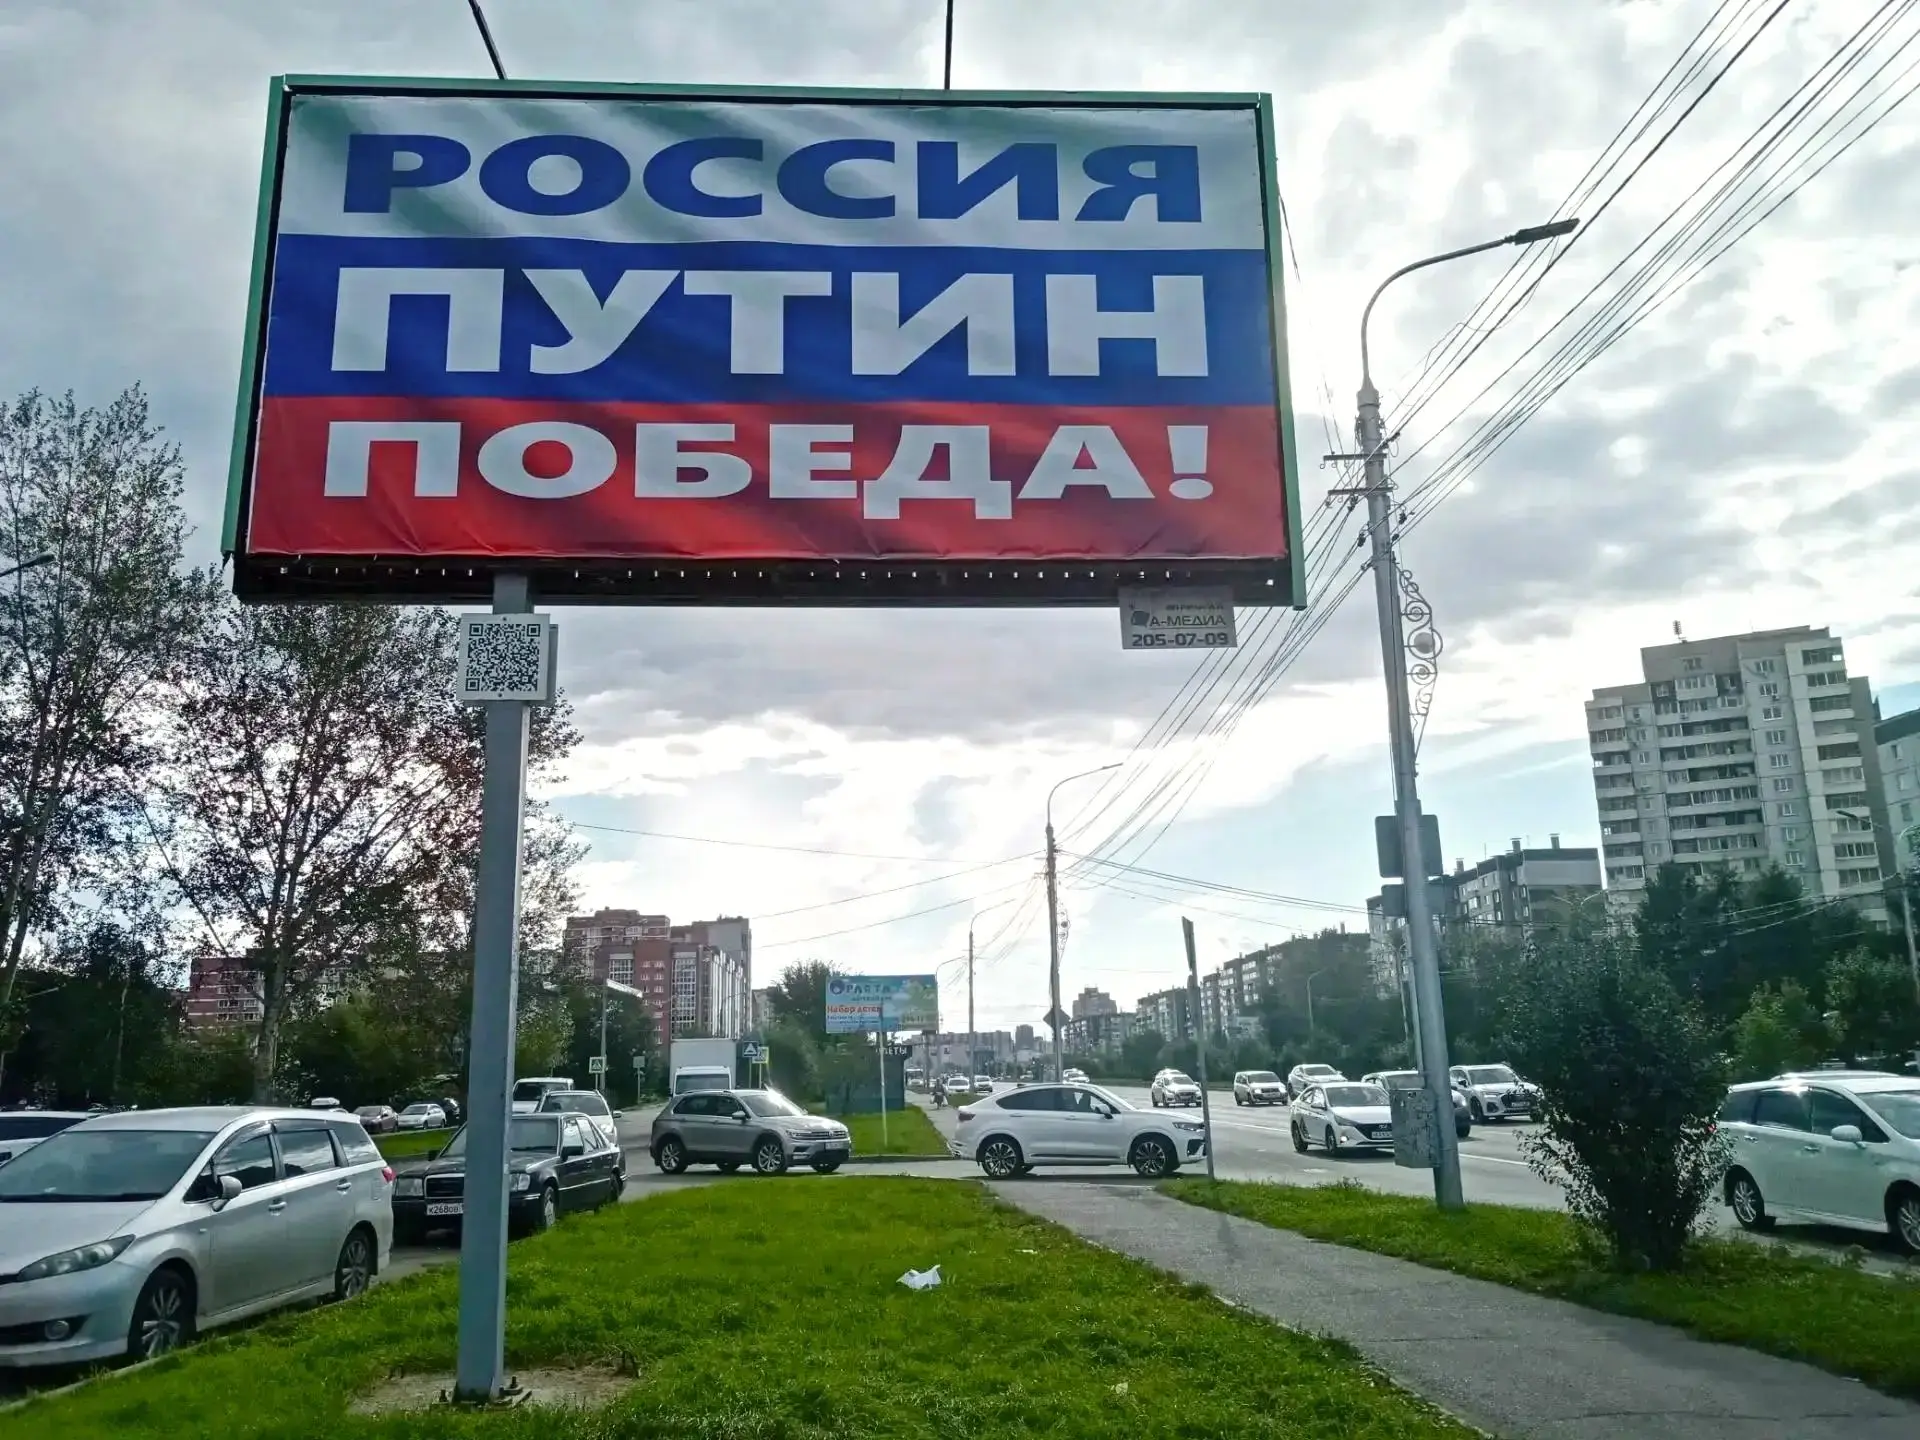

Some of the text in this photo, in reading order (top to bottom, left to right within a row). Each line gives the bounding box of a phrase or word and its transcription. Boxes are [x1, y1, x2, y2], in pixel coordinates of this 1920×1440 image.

[342, 132, 1203, 223] РОССИЯ
[331, 267, 1209, 377] ПУТИН
[323, 420, 1215, 521] ПОБЕДА!
